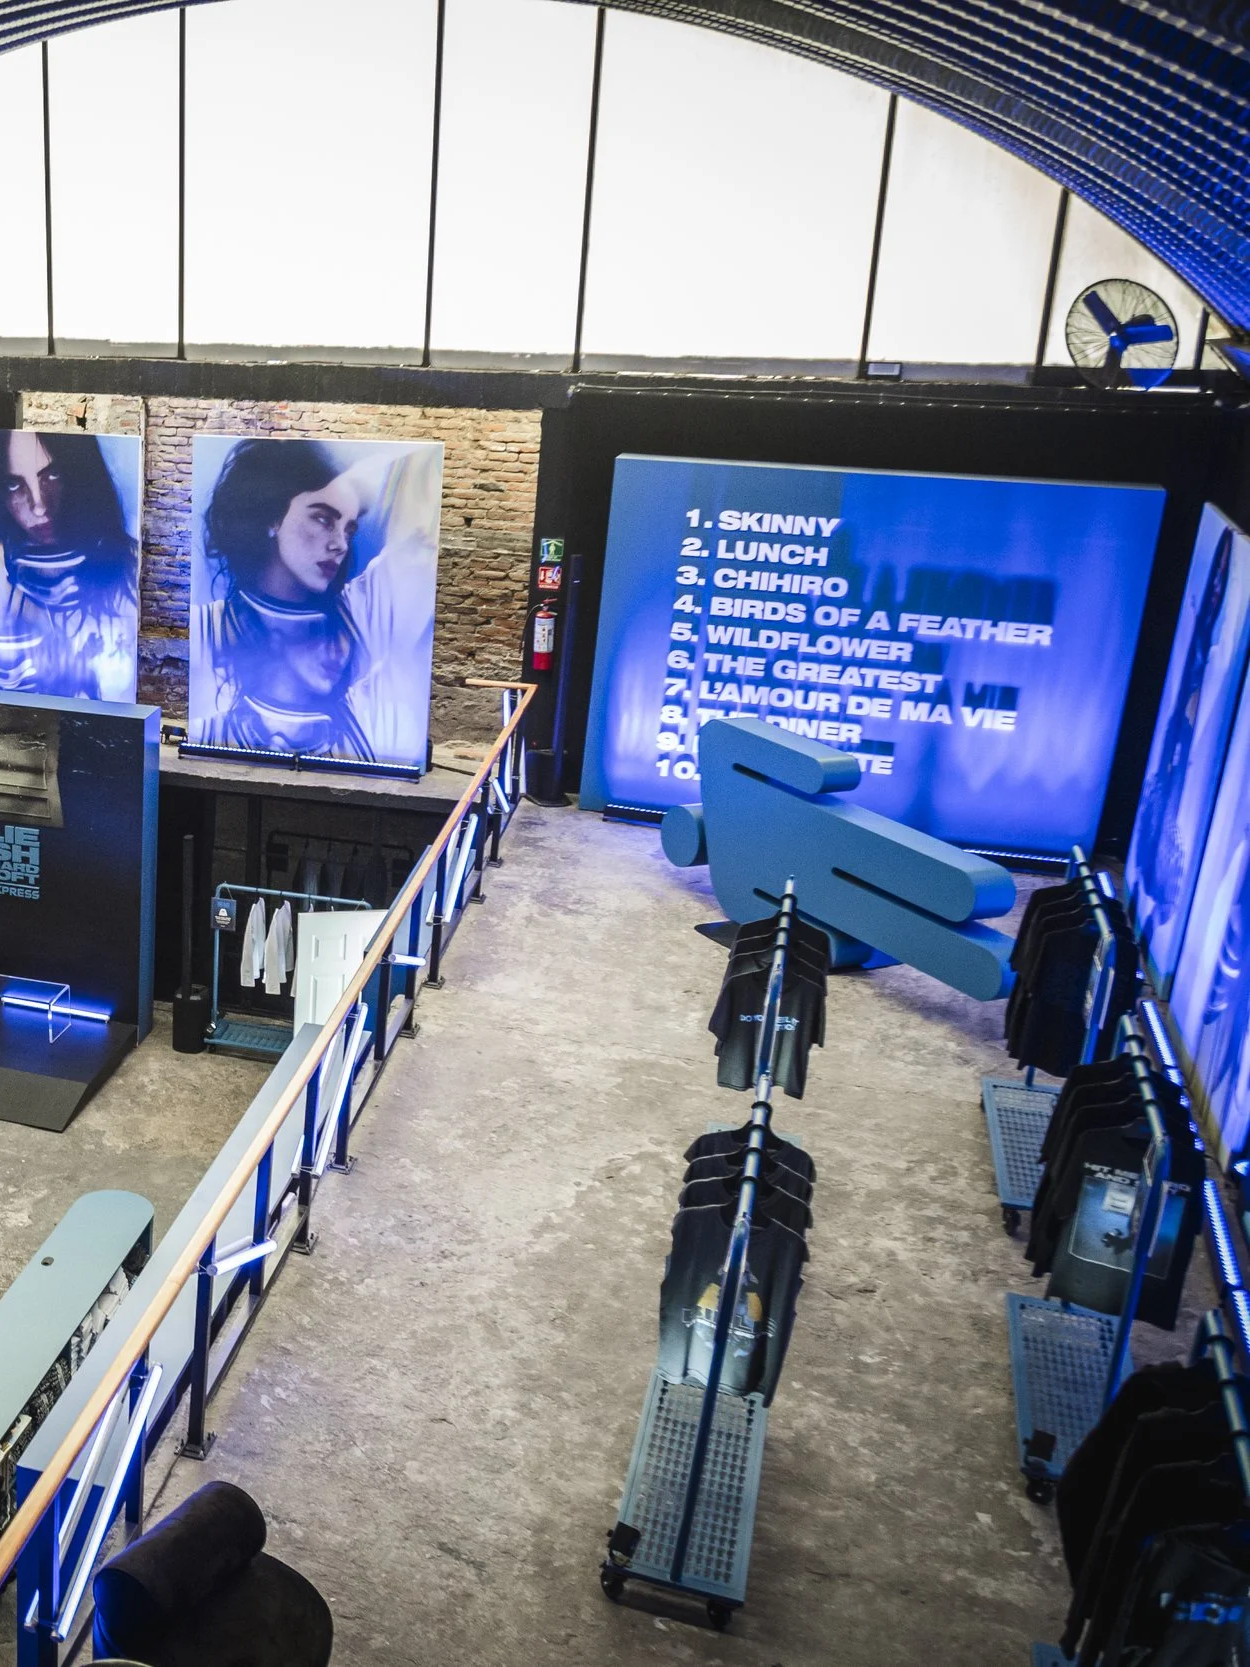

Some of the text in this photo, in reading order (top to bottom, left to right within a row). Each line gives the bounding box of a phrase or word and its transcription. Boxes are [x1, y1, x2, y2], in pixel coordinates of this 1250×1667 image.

[686, 509, 842, 537] 1. SKINNY
[680, 537, 829, 567] 2. LUNCH
[676, 565, 849, 598] 3. CHIHIRO
[673, 594, 1053, 646] 4. BIRDS OF A FEATHER
[670, 622, 913, 662] 5. WILDFLOWER
[666, 650, 943, 694] 6. THE GREATEST
[660, 704, 689, 725] 8.
[664, 677, 1018, 731] 7. L'AMOUR DE MA VIE
[656, 731, 685, 752] 9.
[655, 759, 701, 780] 10.
[1094, 1172, 1131, 1185] AND
